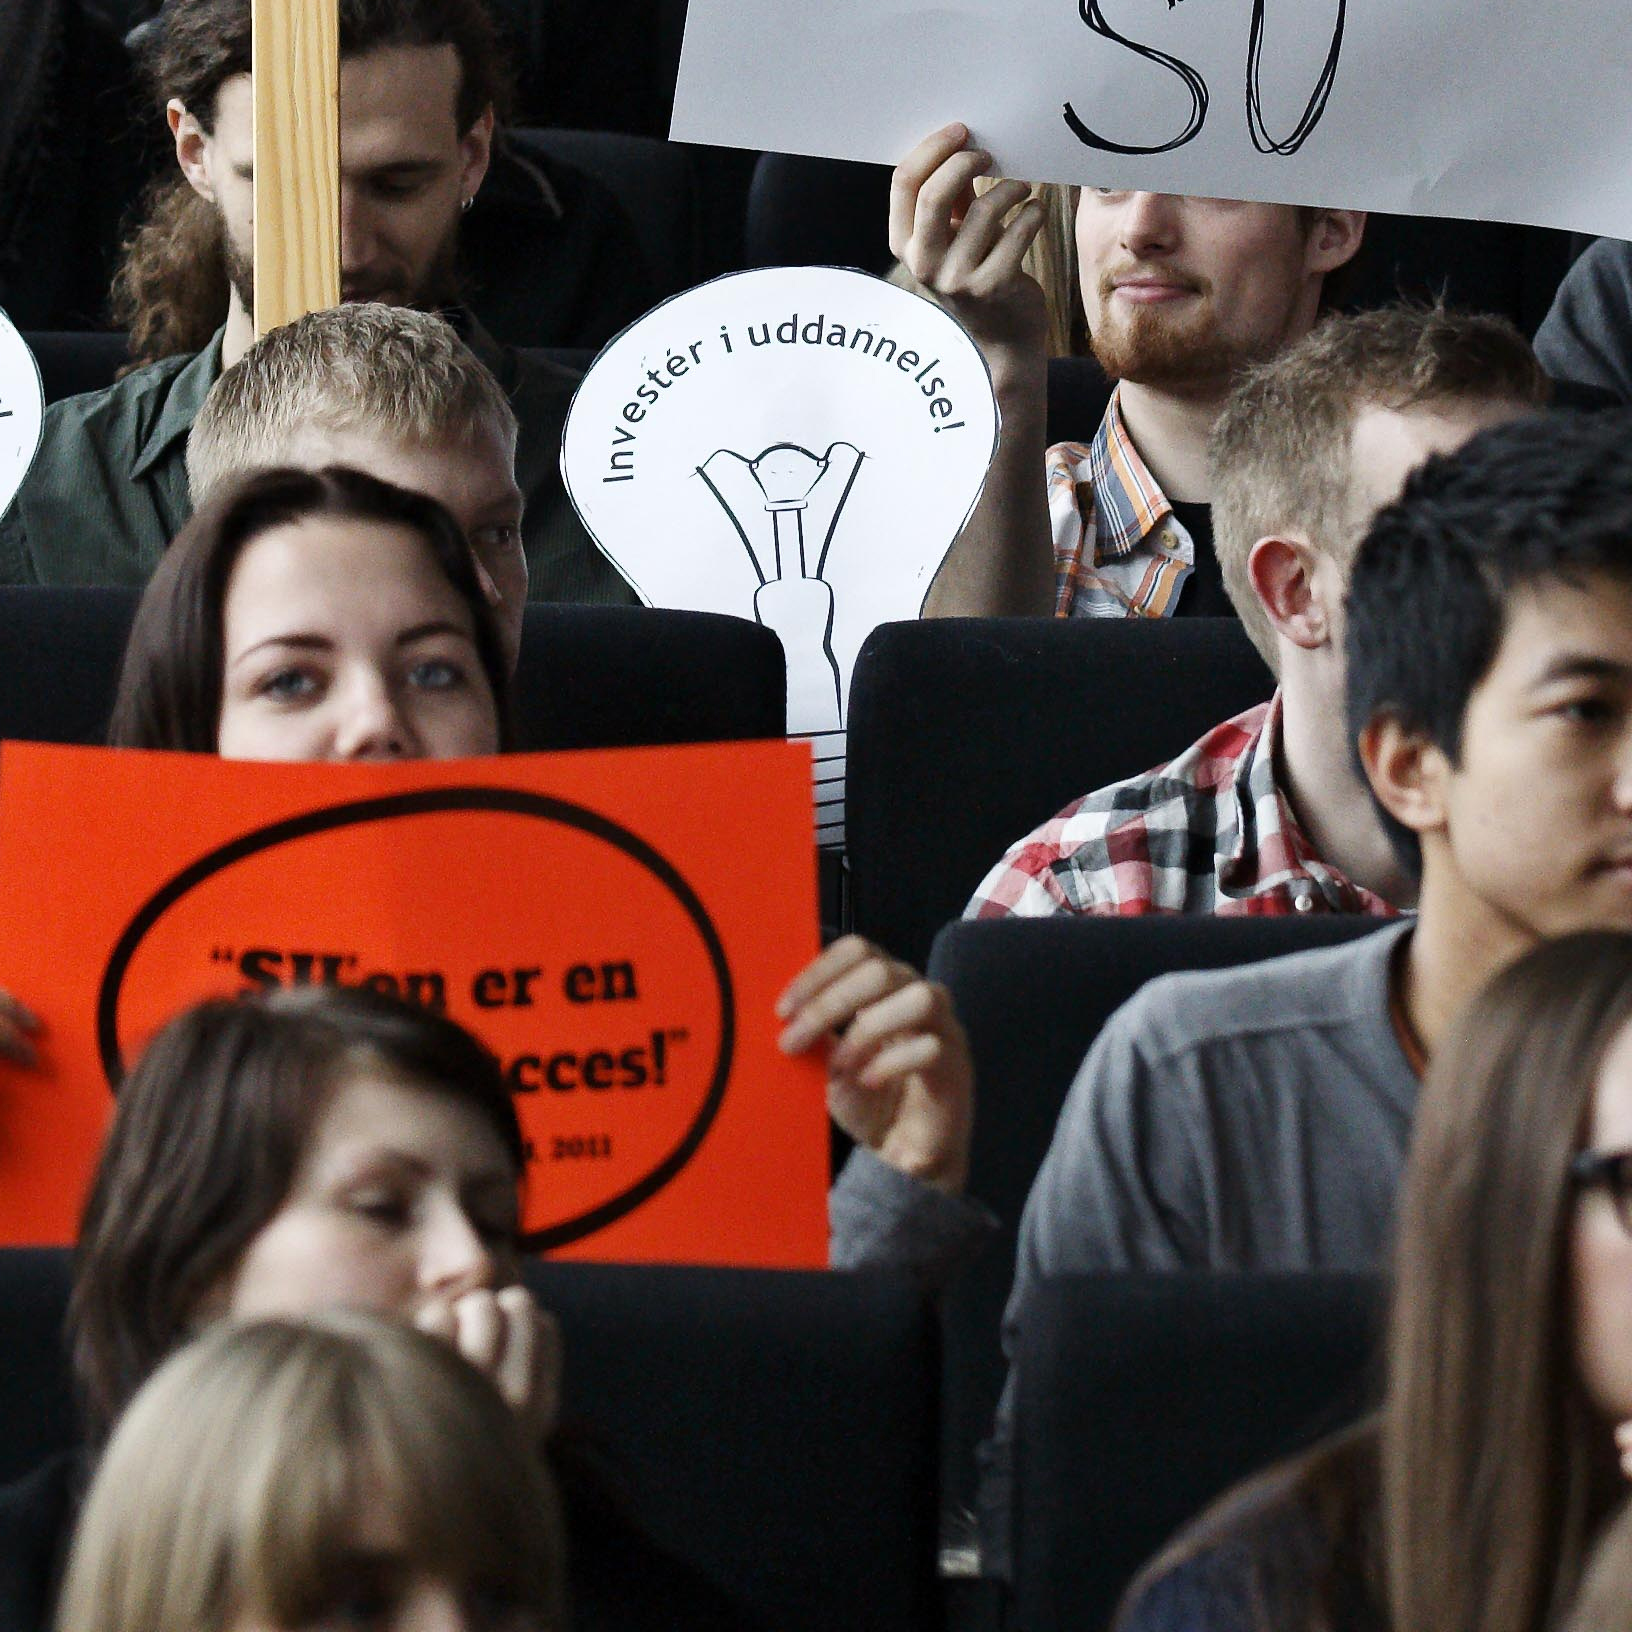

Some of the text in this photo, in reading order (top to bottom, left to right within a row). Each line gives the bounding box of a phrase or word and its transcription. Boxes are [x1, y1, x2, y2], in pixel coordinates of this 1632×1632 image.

[602, 313, 966, 483] Investér i uddannelse!
[473, 966, 543, 1009] er
[564, 959, 639, 1005] en
